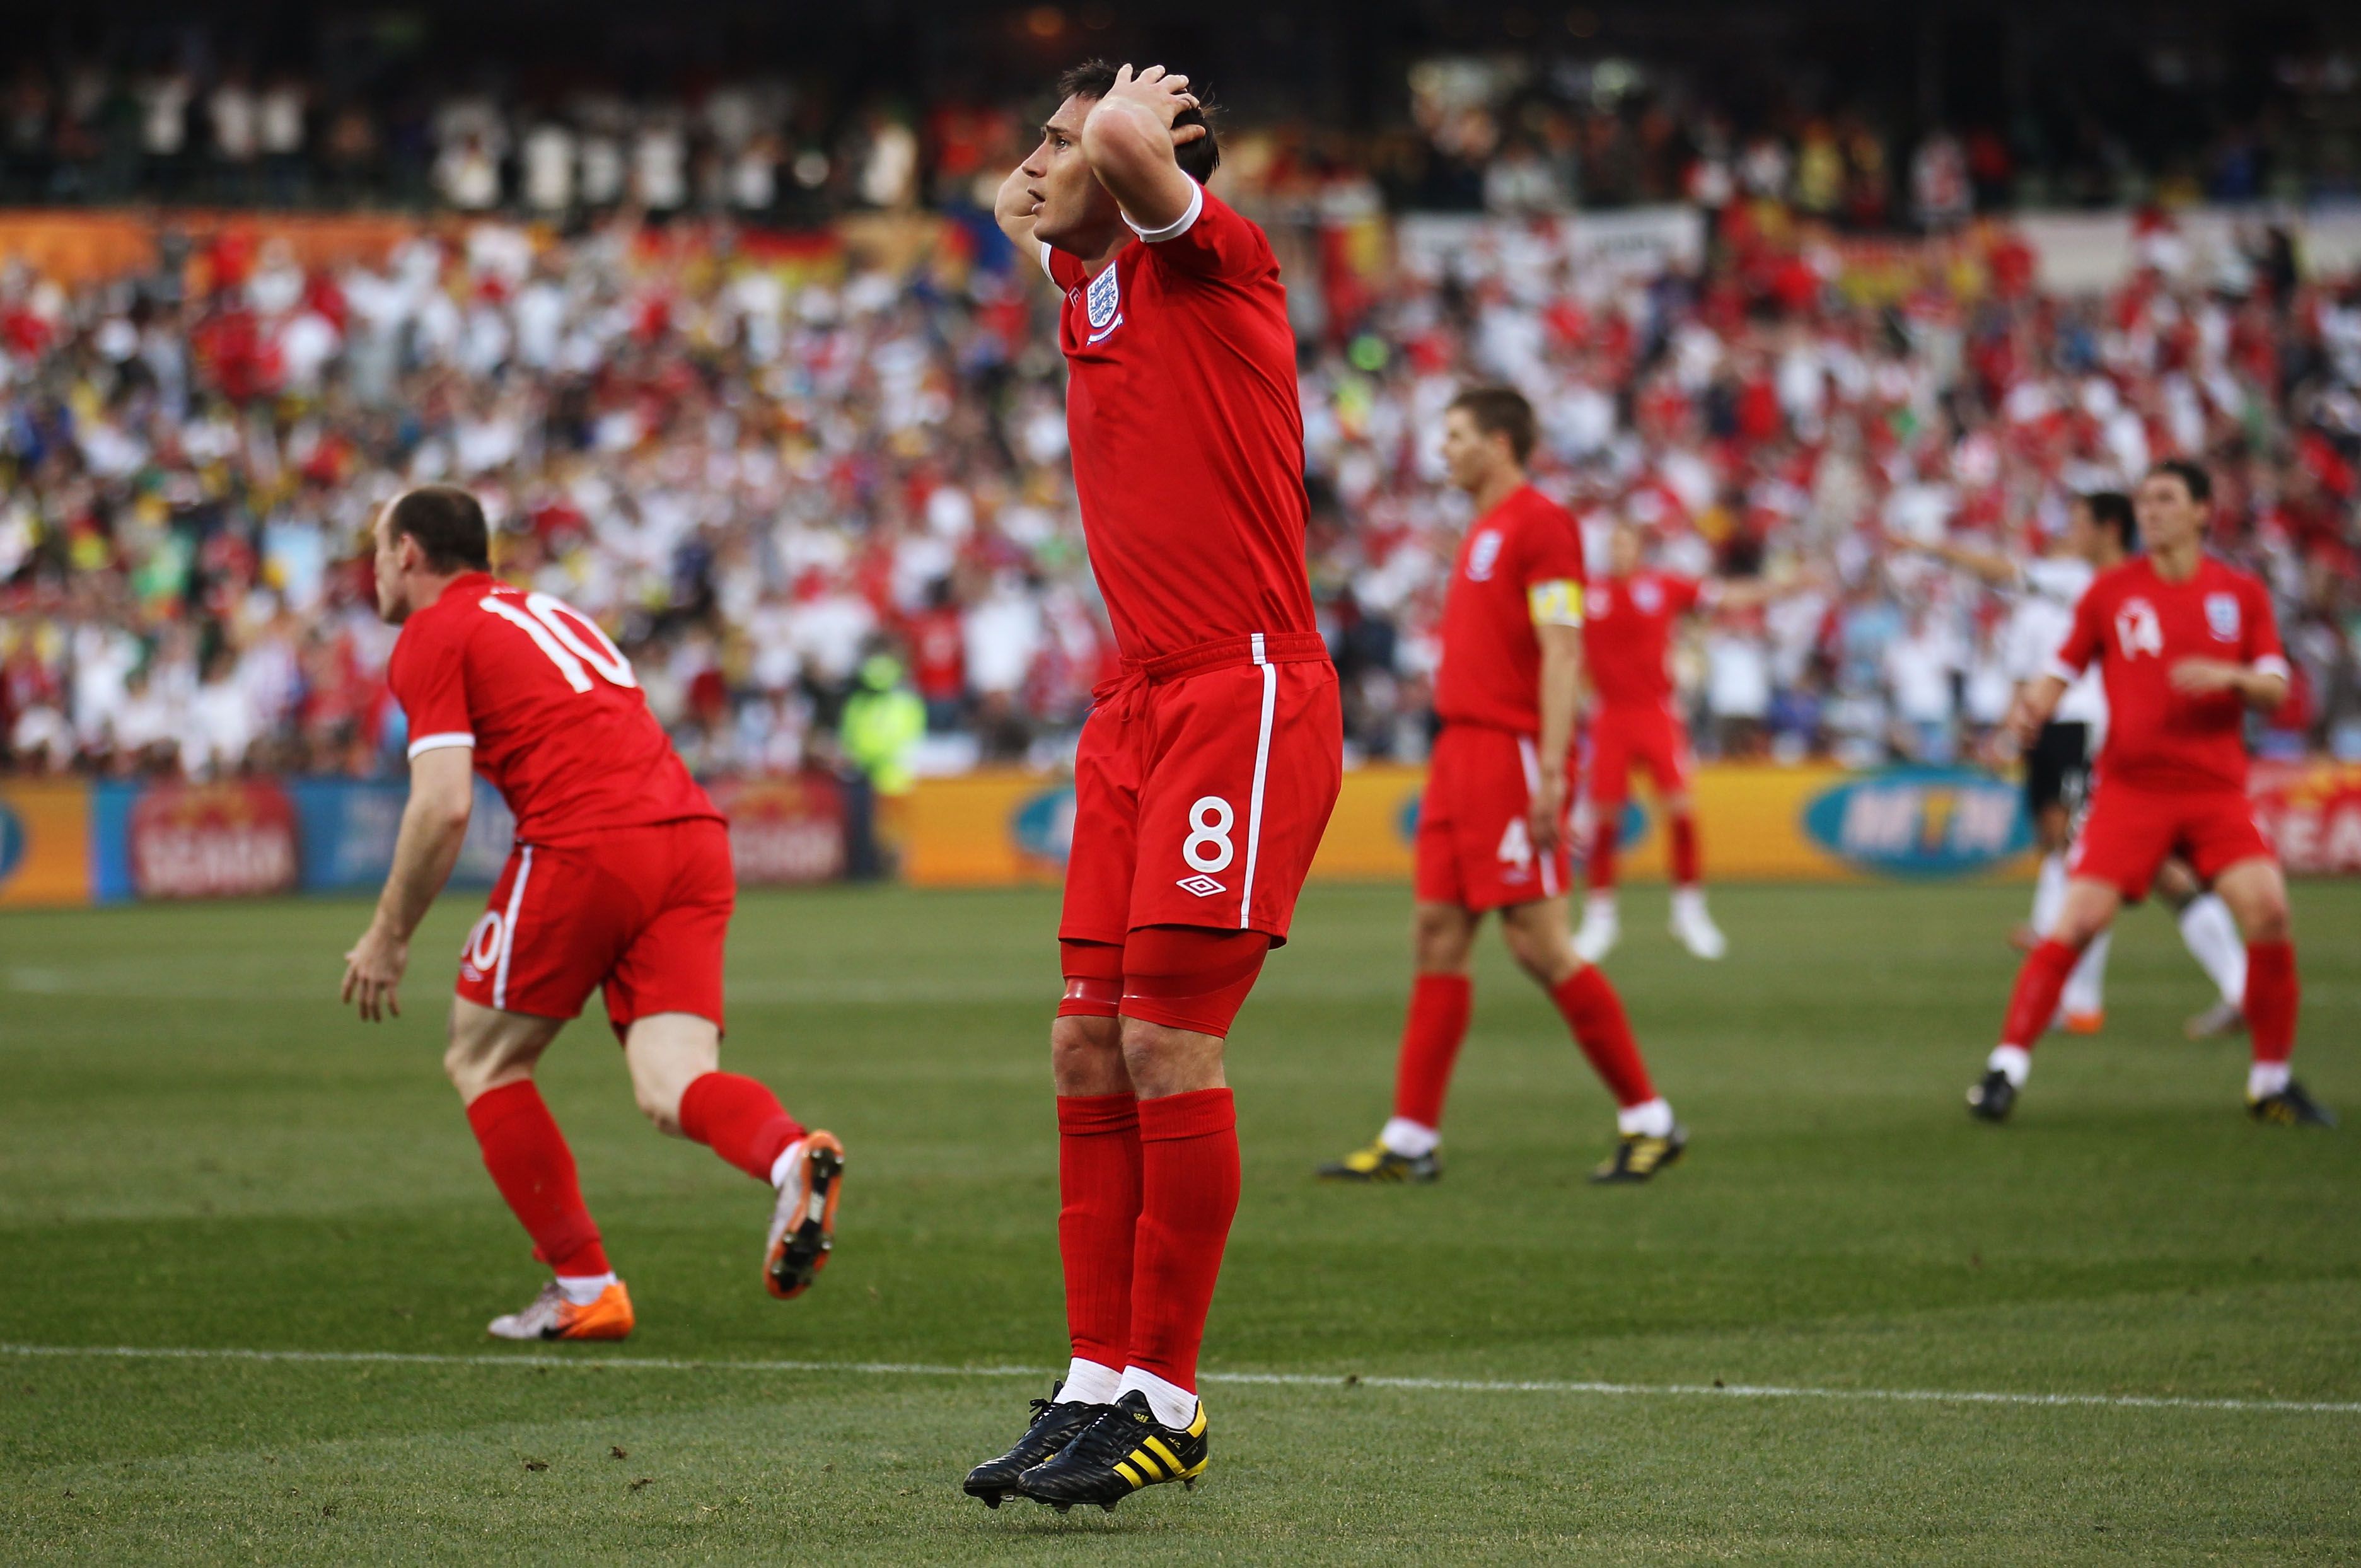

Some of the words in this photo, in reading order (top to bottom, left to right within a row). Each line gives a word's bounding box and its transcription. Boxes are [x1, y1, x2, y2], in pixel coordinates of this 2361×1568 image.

[479, 591, 638, 694] 10
[1183, 796, 1234, 873] 8
[1497, 816, 1532, 872] 4
